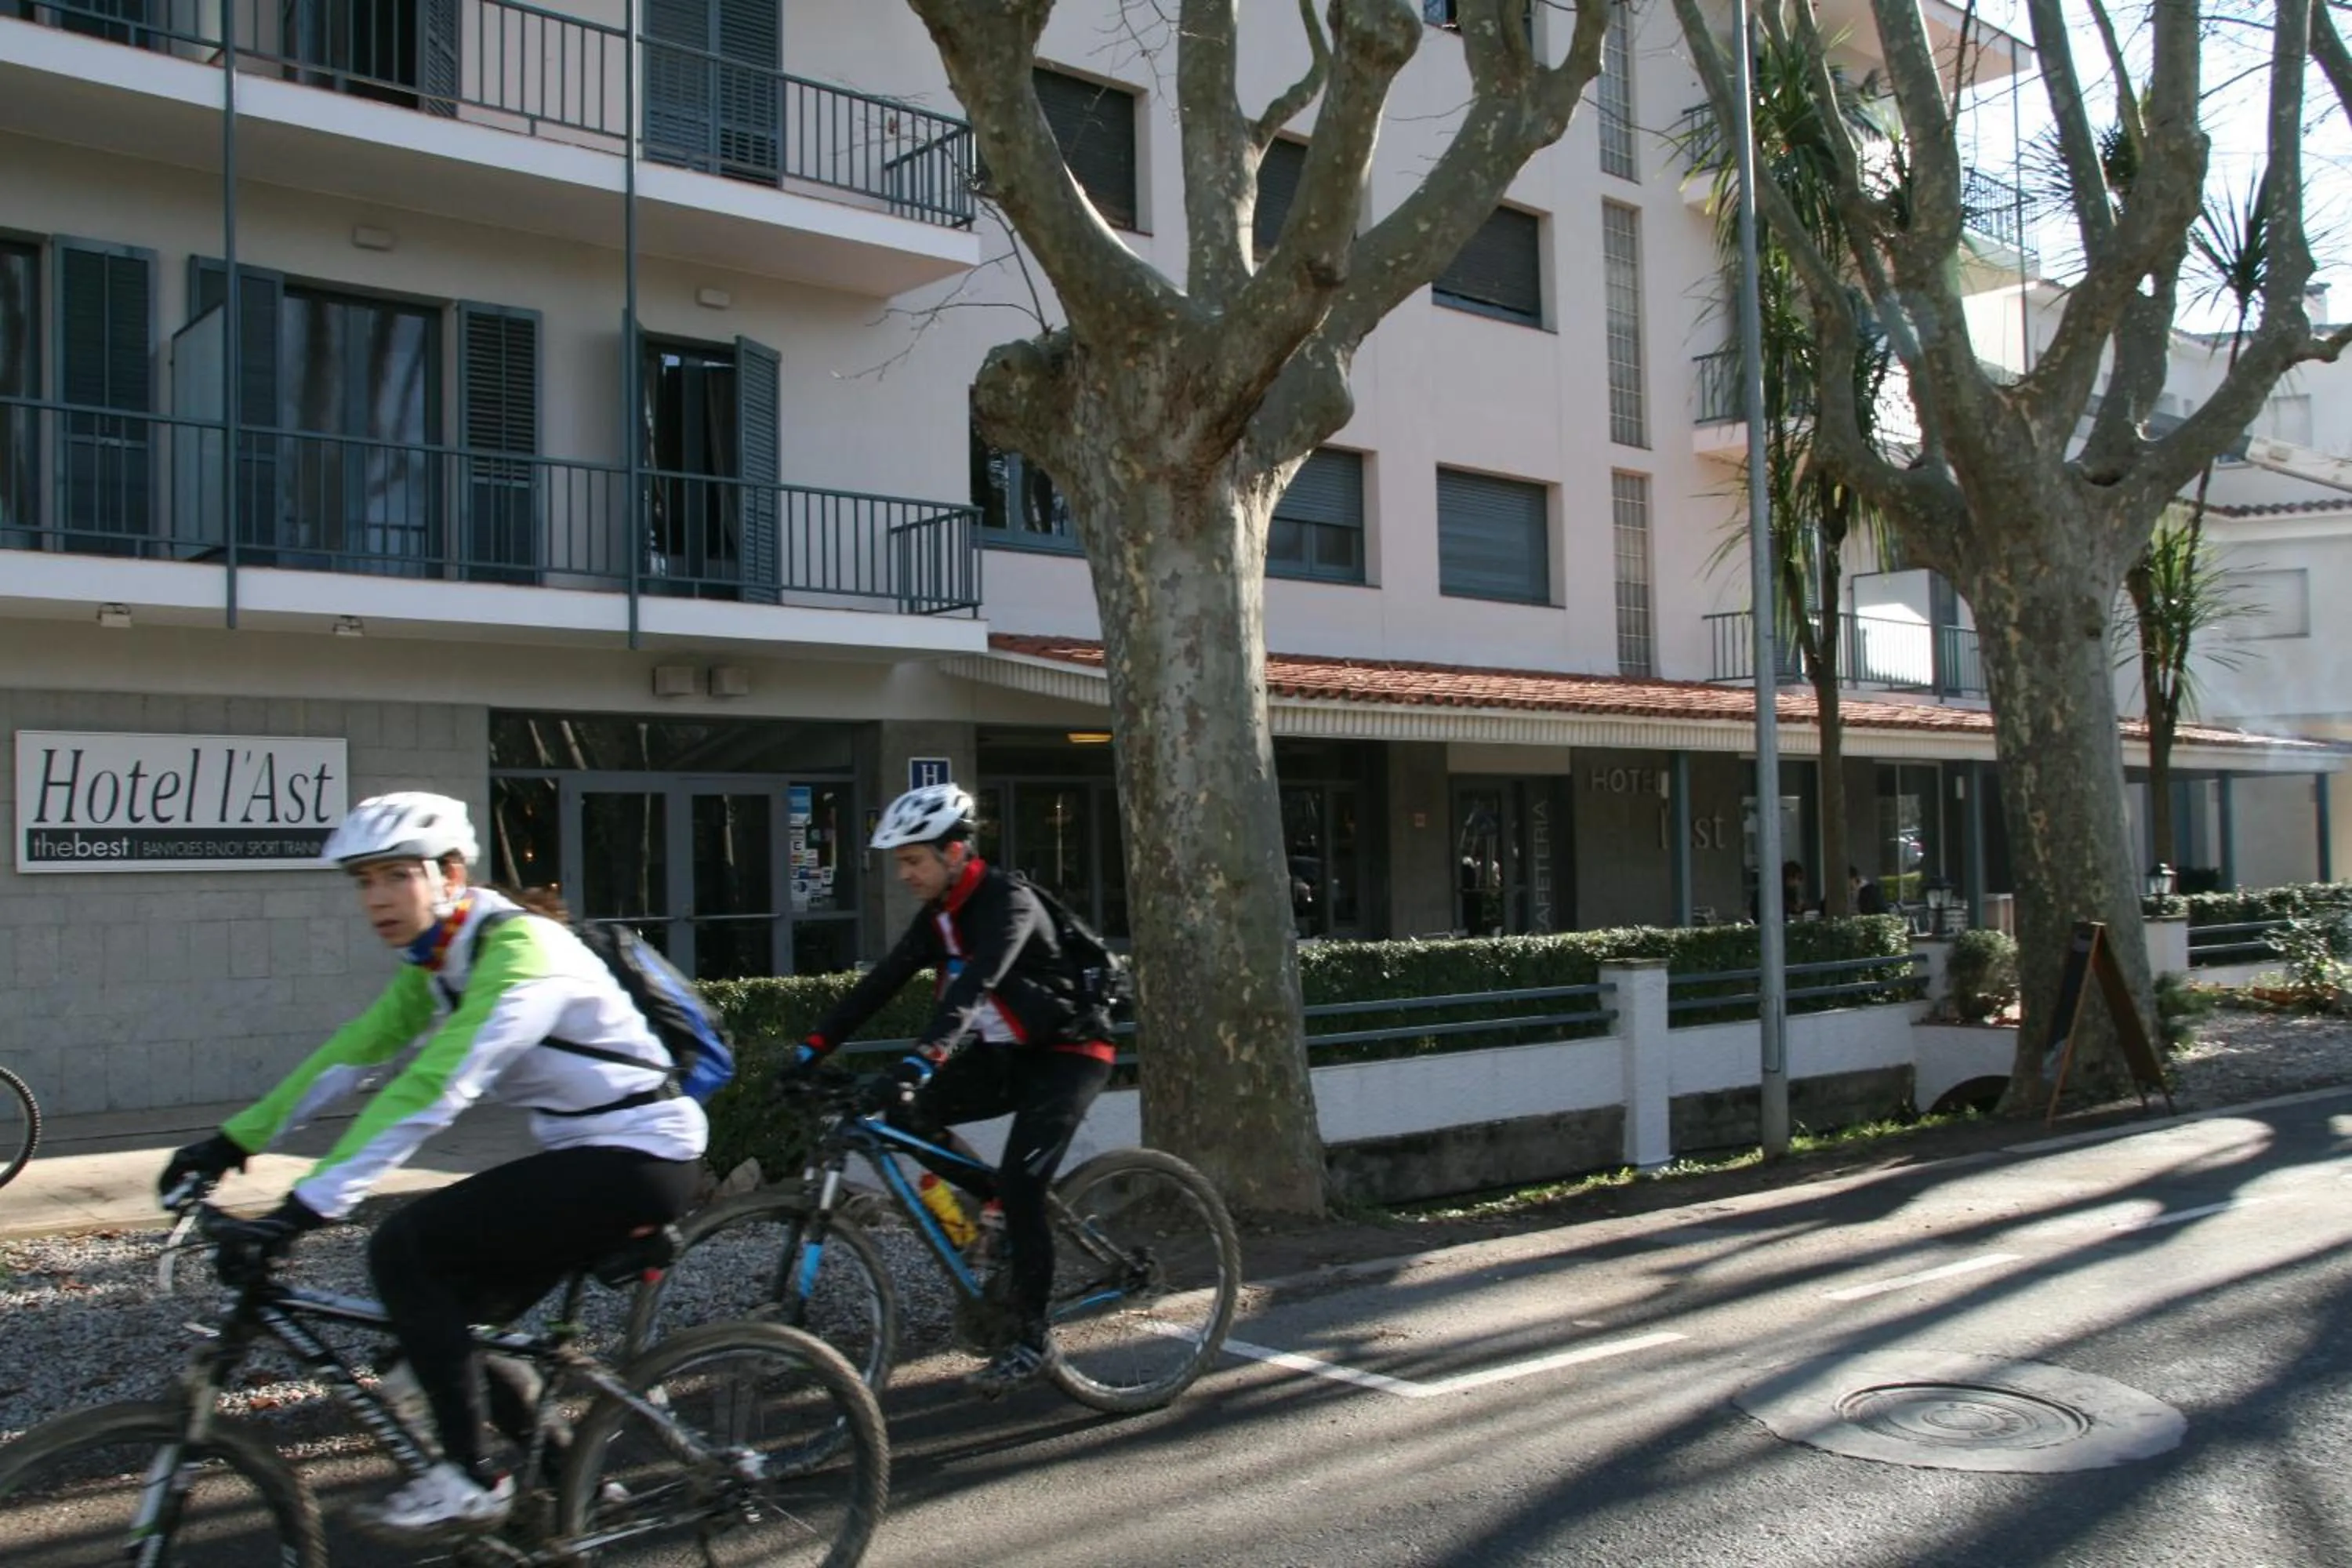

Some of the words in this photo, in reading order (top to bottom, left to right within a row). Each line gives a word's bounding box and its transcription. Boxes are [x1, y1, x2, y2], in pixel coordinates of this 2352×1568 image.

[34, 748, 201, 823] Hotel
[219, 748, 333, 823] l'Ast
[920, 764, 938, 786] H
[34, 833, 130, 858] thebest
[206, 840, 244, 856] ENJOY
[246, 840, 280, 856] SPORT
[1531, 800, 1551, 931] AFETERIA
